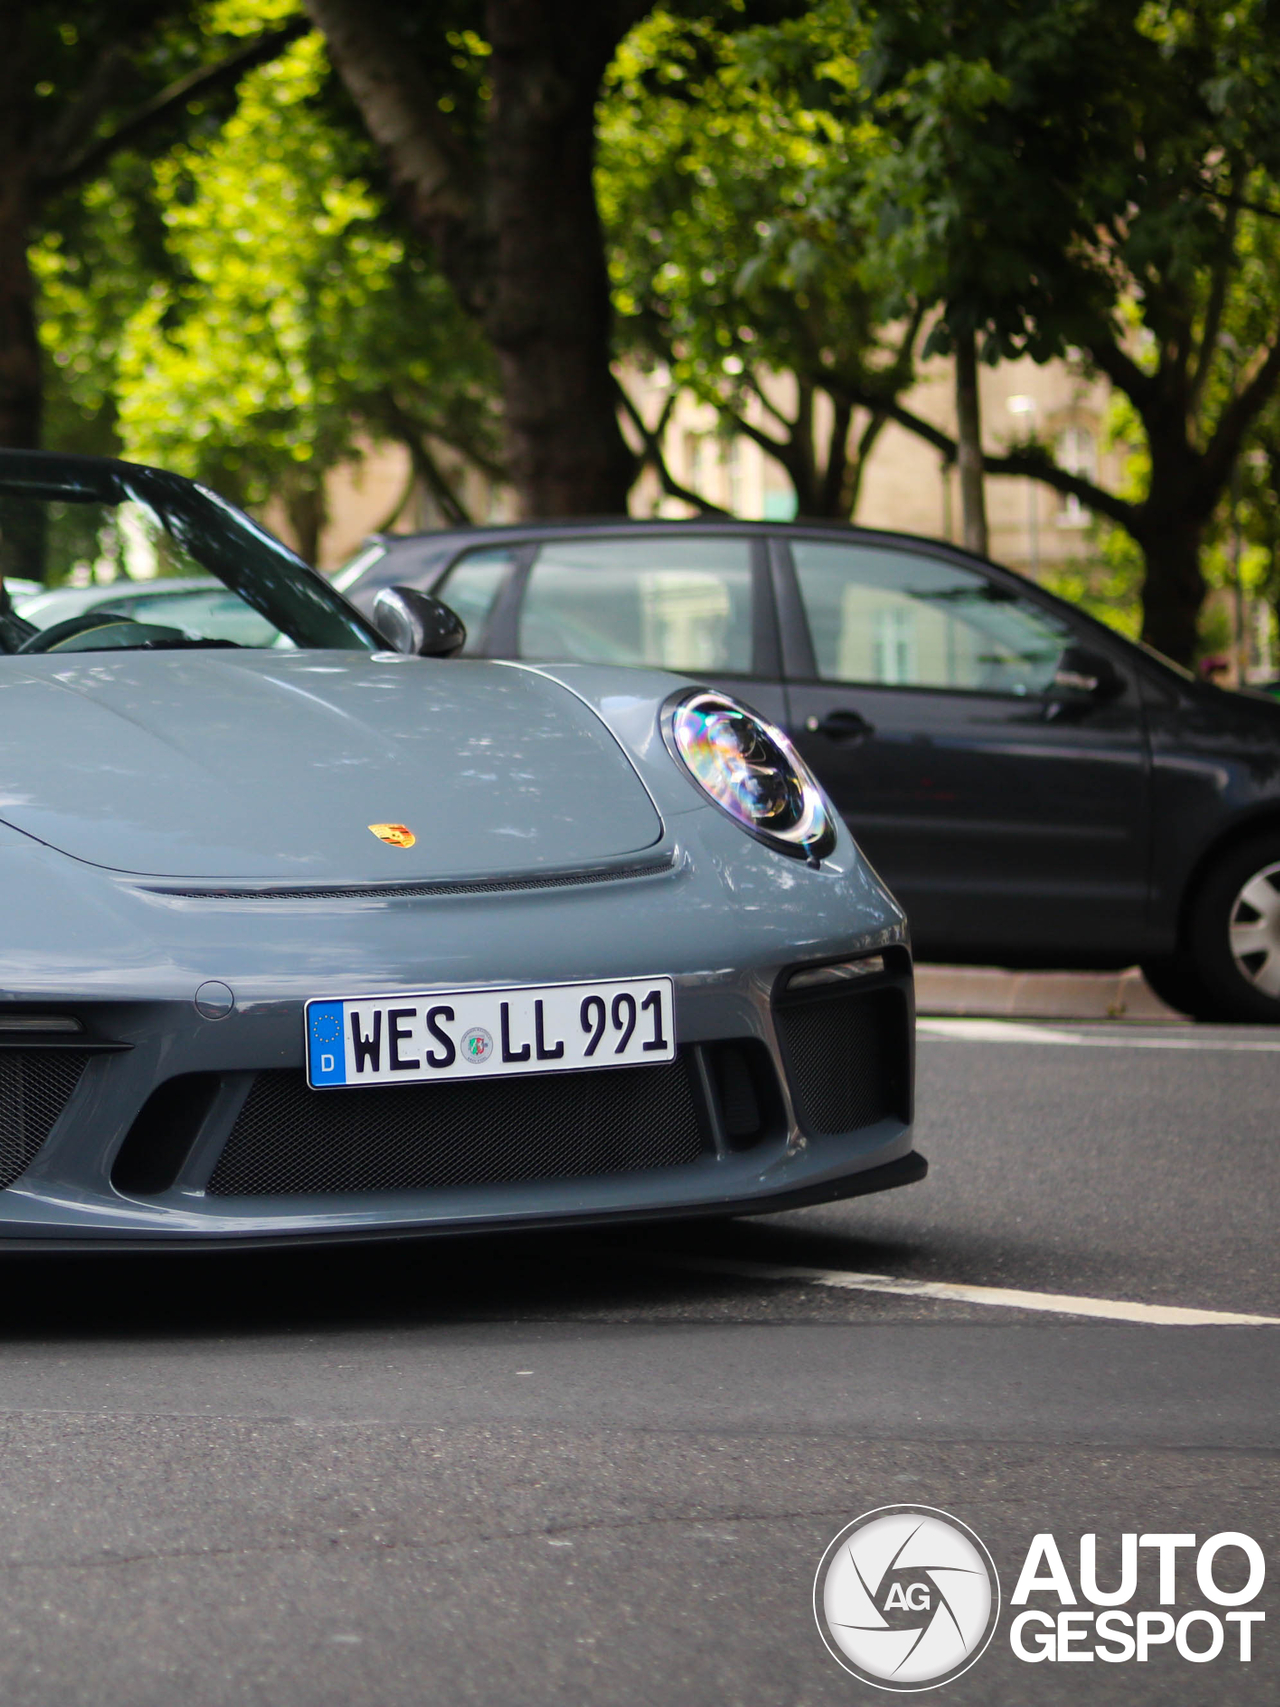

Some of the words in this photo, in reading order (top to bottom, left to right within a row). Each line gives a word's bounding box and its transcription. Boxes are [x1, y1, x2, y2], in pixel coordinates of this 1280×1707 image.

[350, 1006, 457, 1073] WES
[500, 999, 565, 1062] LL
[579, 990, 668, 1057] 991
[321, 1054, 335, 1072] D
